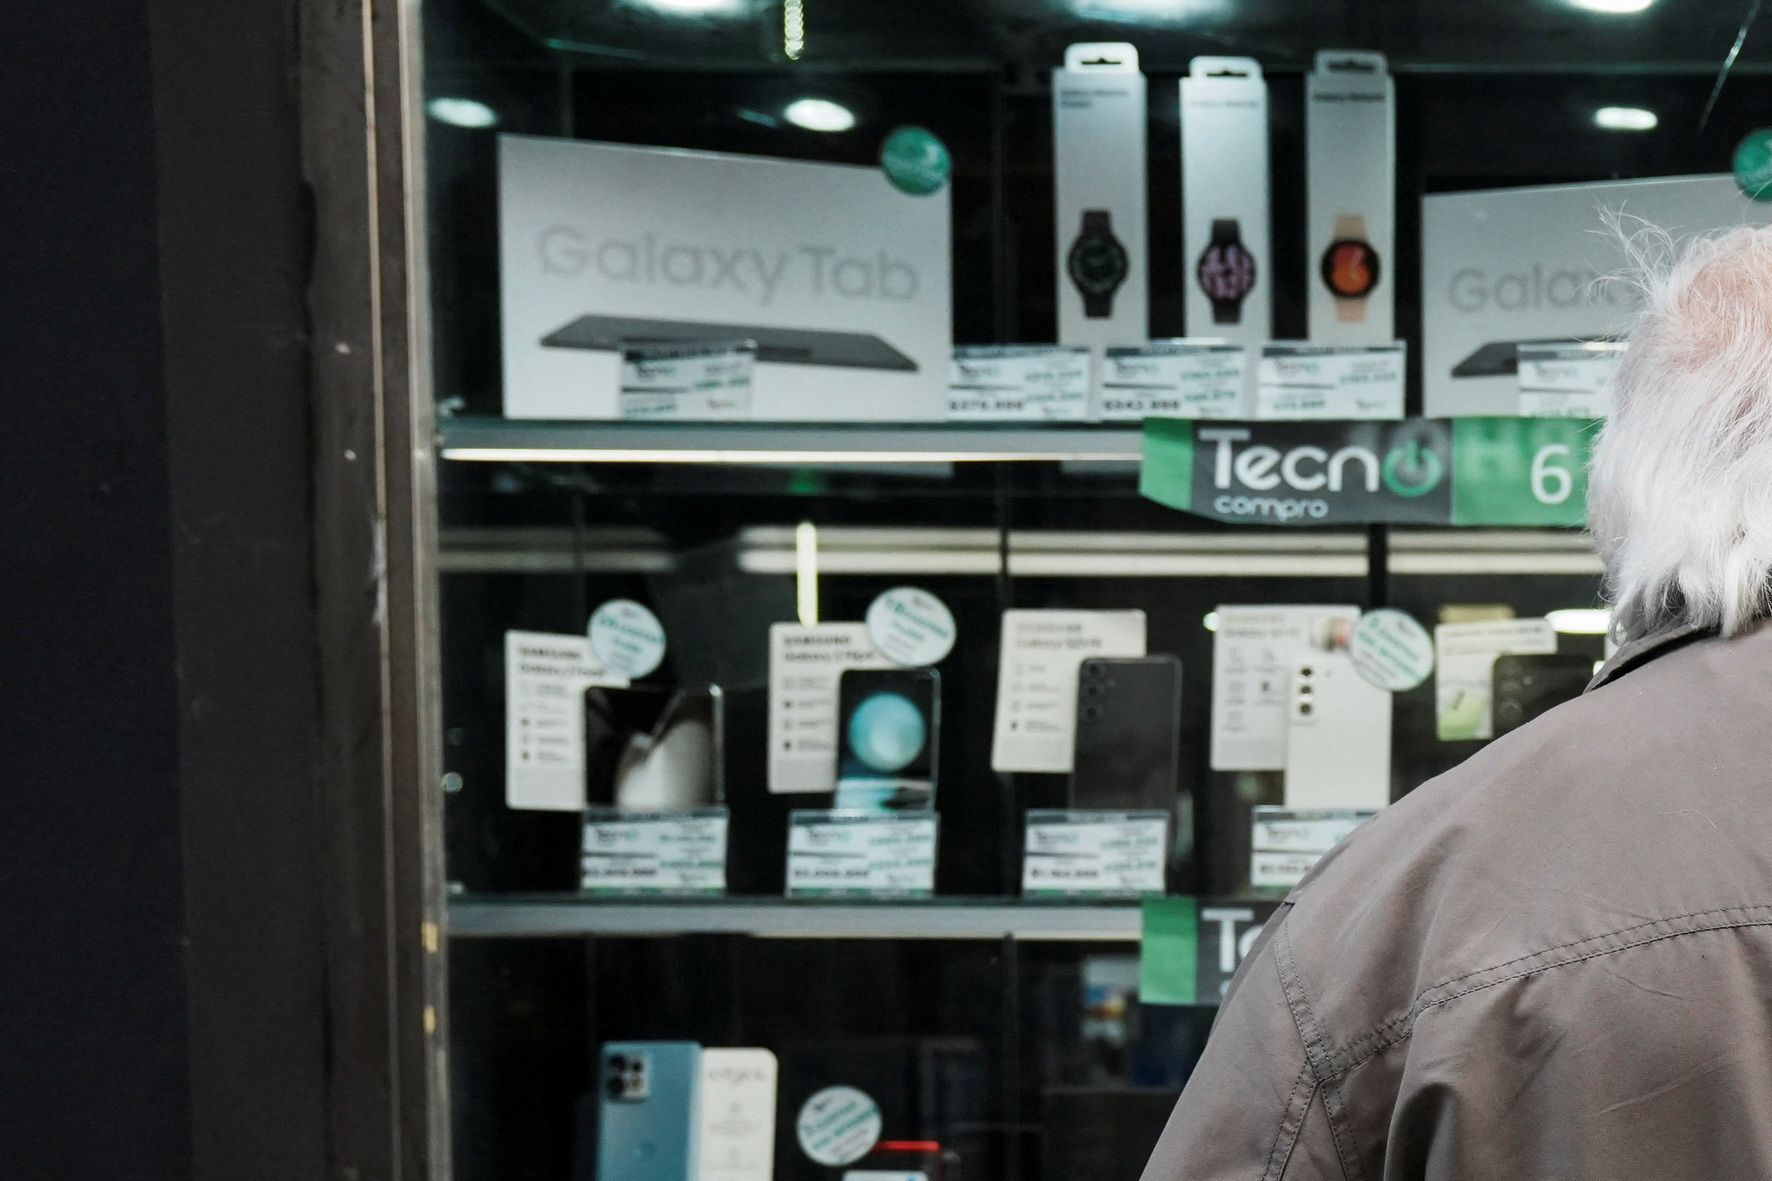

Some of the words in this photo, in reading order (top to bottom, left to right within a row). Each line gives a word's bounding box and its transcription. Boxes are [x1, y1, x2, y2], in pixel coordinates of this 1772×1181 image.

[535, 223, 789, 306] Galaxy
[800, 245, 921, 301] Tab
[1449, 262, 1625, 312] Gala
[1530, 444, 1574, 504] 6
[1213, 495, 1329, 523] compro
